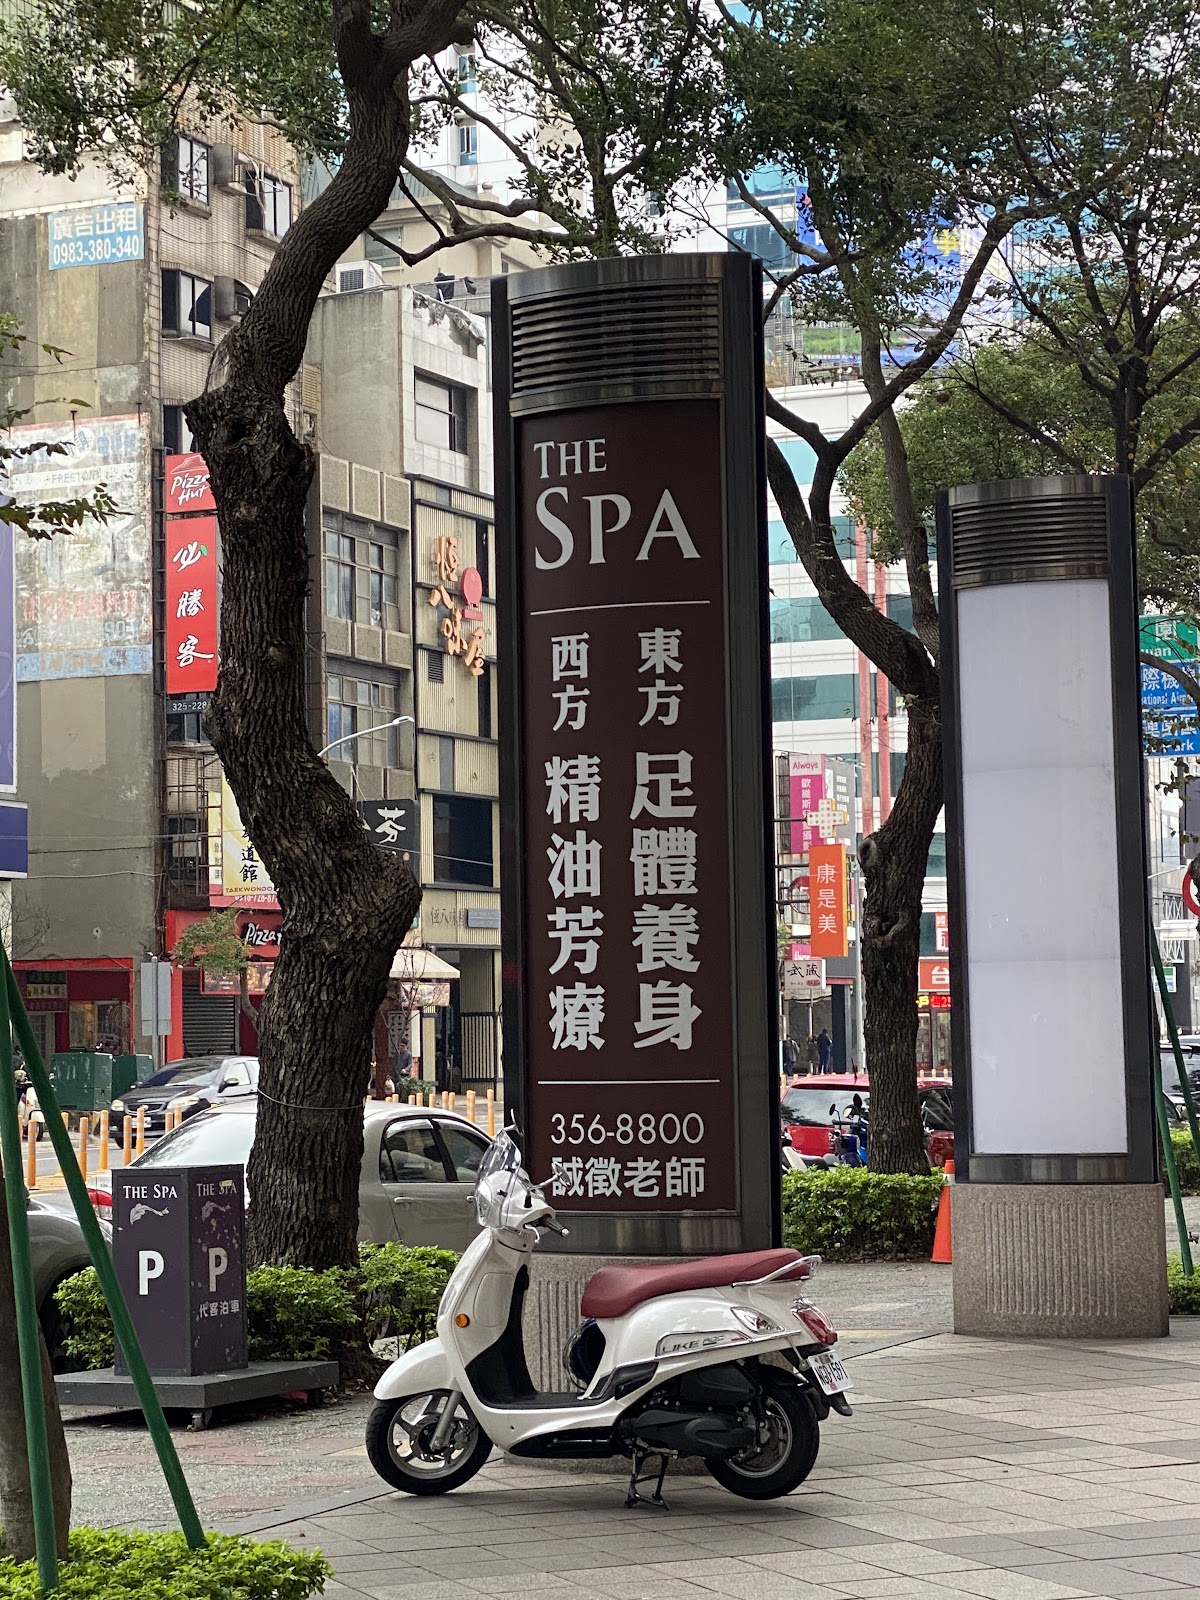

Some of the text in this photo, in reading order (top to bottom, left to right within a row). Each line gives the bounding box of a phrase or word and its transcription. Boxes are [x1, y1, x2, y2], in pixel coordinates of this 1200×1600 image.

[53, 207, 137, 240] 廣告出租
[54, 234, 139, 265] 0983-380-340
[533, 438, 607, 479] THE
[178, 485, 209, 506] Hut
[535, 486, 701, 570] SPA
[172, 540, 214, 667] 必勝客
[1156, 619, 1176, 641] 園
[172, 701, 210, 711] 325-228
[792, 762, 819, 770] Always
[545, 631, 605, 1051] 西方 精油芳療
[629, 627, 702, 1050] 東方 足體養身
[816, 863, 837, 934] 康是美
[245, 922, 276, 945] Pizza
[551, 1112, 704, 1145] 356-8800
[123, 1183, 178, 1199] THE SPA
[196, 1183, 215, 1197] THE
[551, 1156, 706, 1198] 誠徵老師
[139, 1250, 165, 1296] P
[208, 1247, 228, 1293] P
[199, 1299, 240, 1319] 代客泊車
[662, 1340, 699, 1354] LIKE
